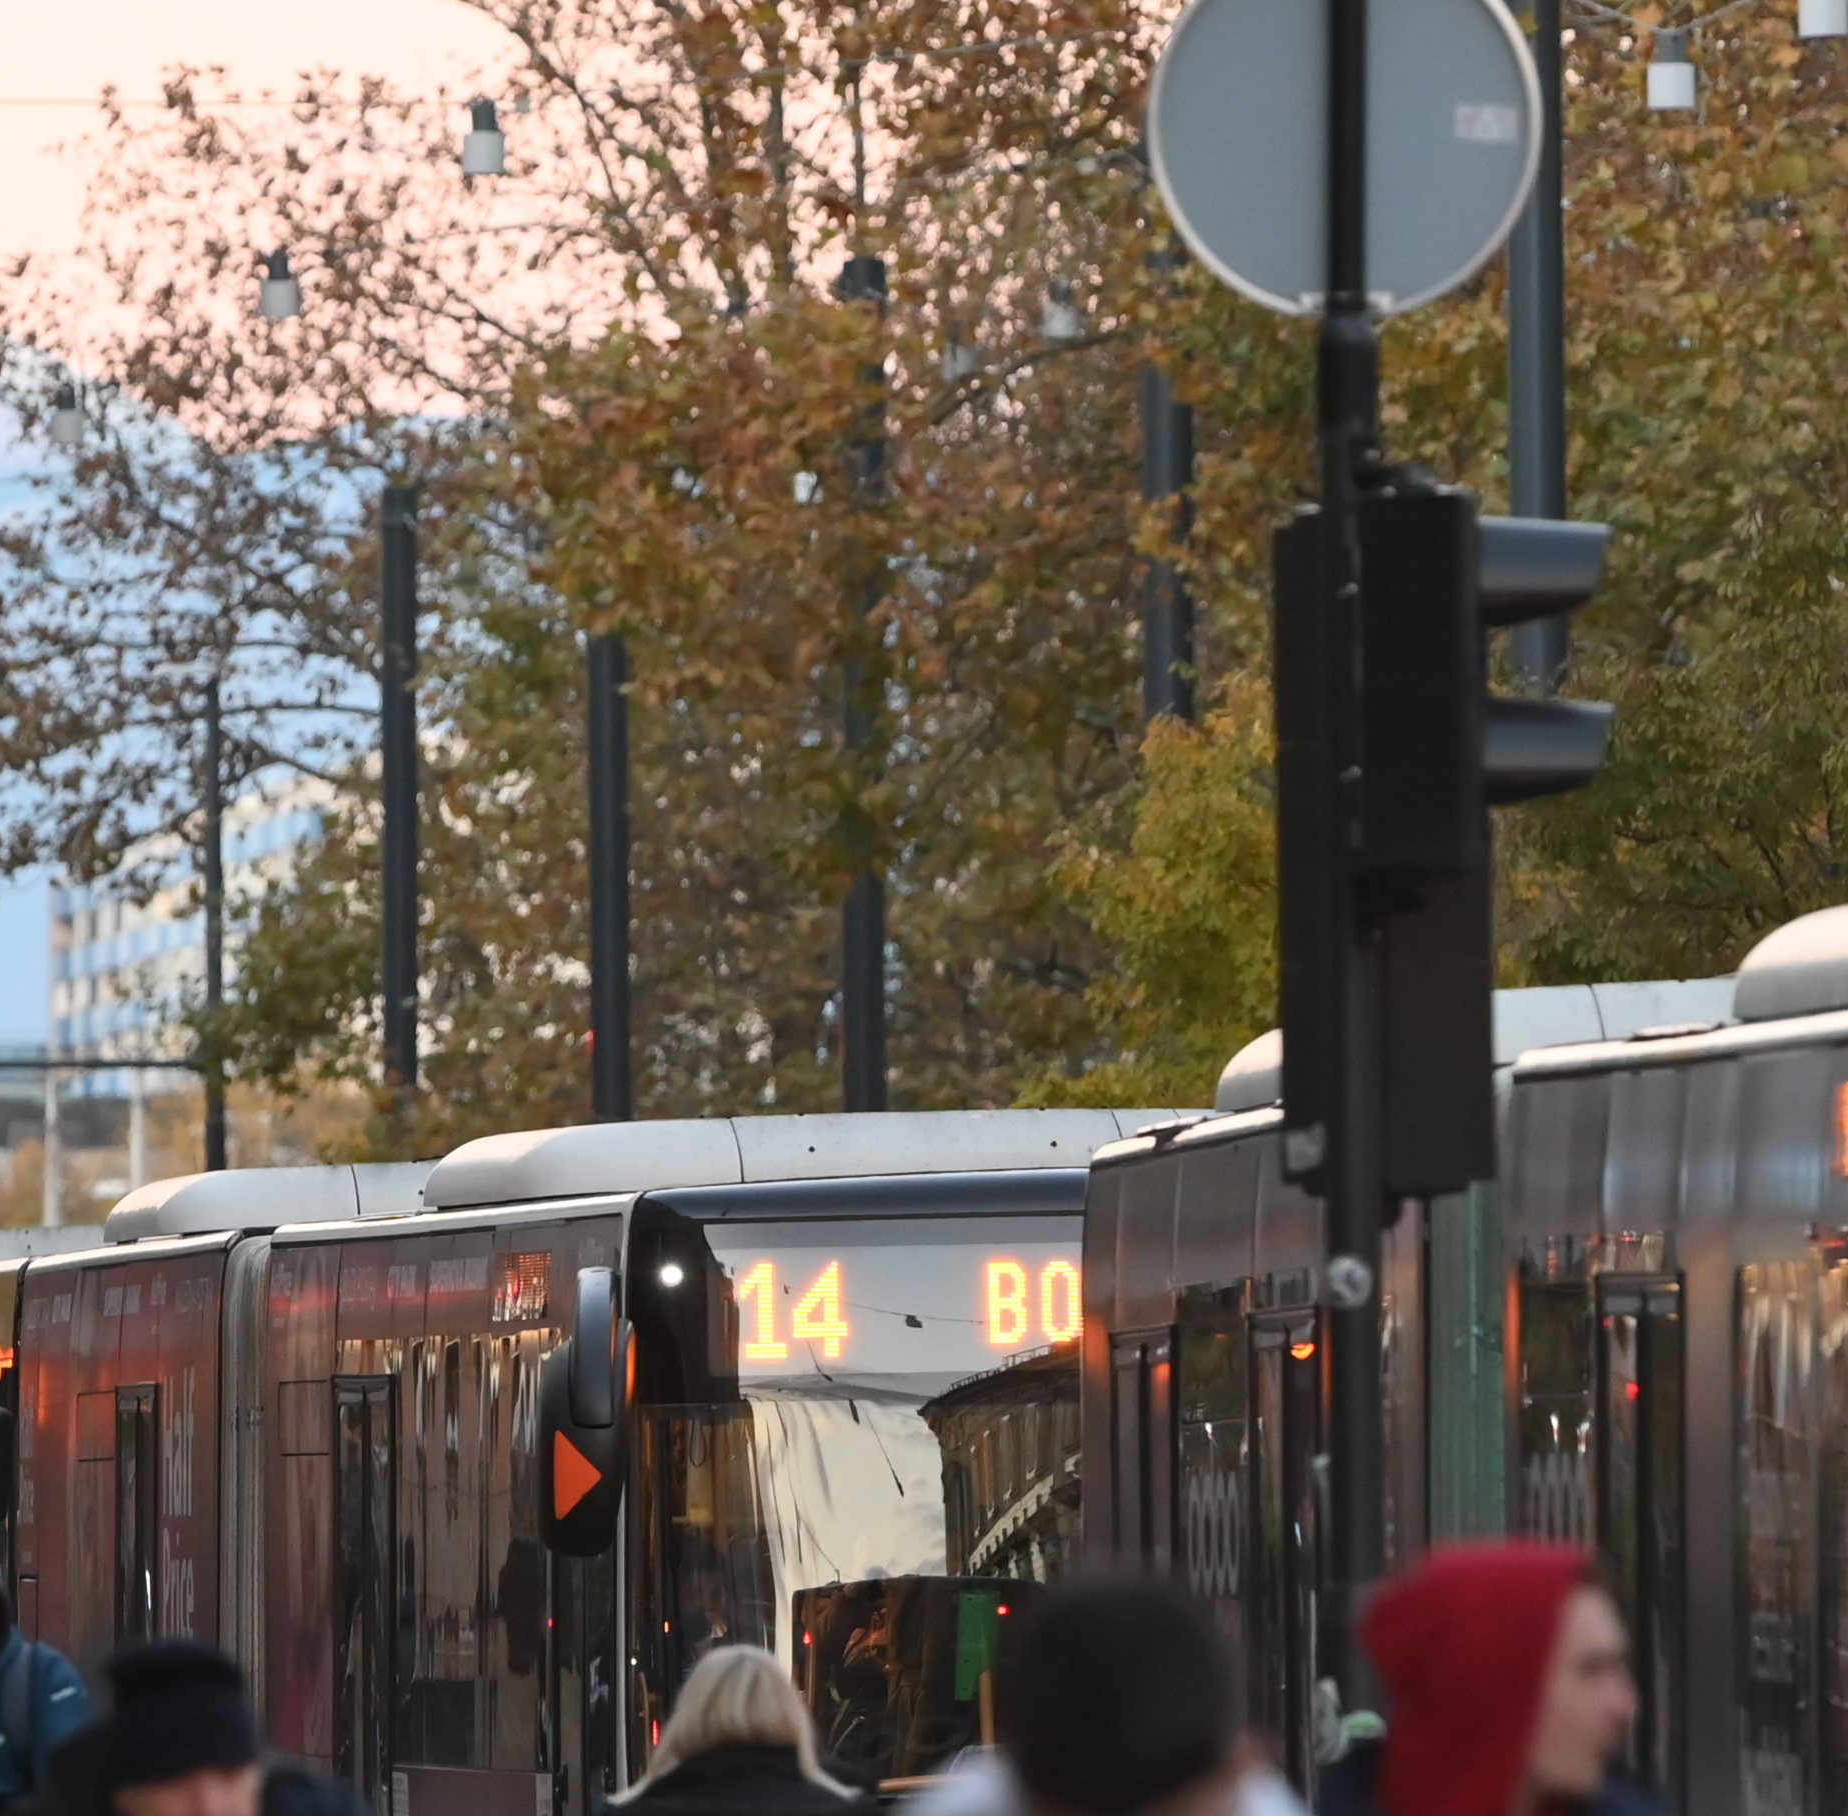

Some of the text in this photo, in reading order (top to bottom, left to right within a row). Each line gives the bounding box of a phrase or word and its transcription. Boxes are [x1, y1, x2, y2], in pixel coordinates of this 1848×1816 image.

[738, 1261, 850, 1361] 14
[163, 1366, 196, 1516] Half
[163, 1526, 195, 1639] Price
